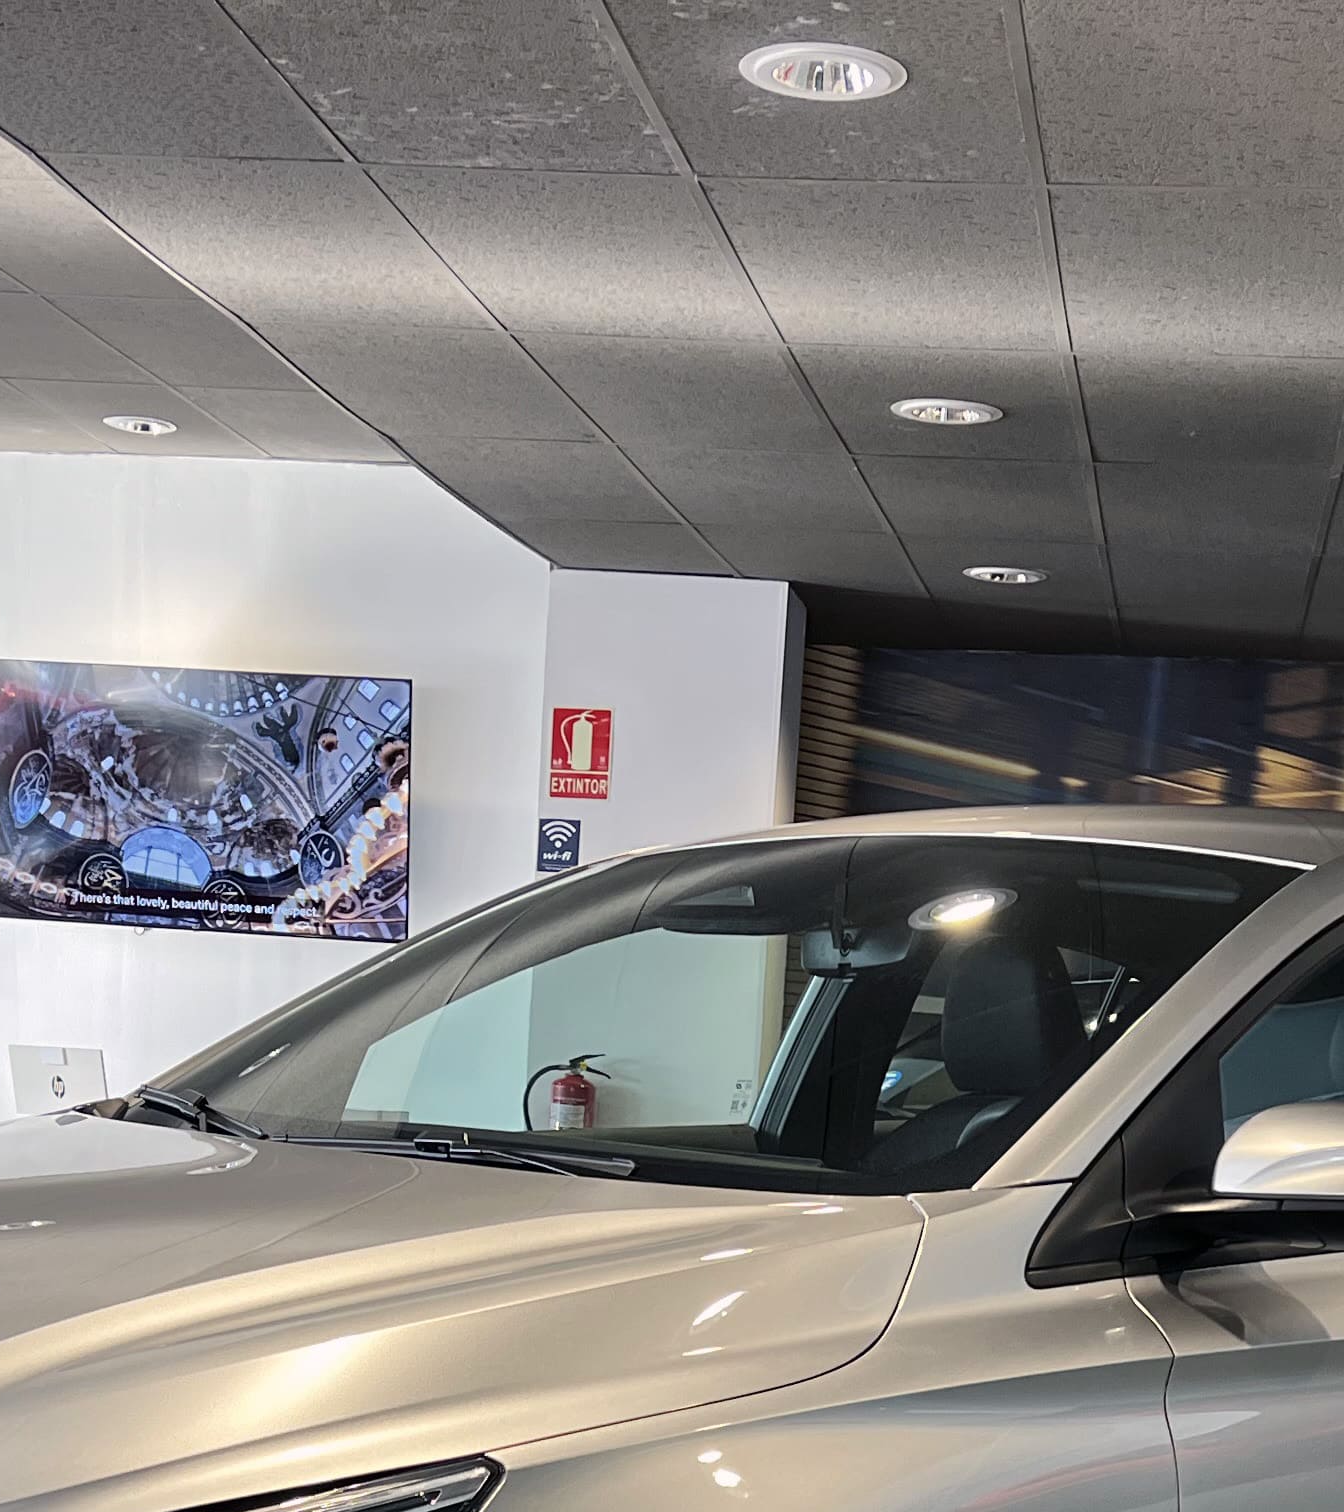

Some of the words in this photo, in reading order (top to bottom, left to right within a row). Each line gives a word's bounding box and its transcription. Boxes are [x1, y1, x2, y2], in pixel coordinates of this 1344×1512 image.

[551, 777, 607, 795] EXTINTOR
[542, 850, 572, 862] wi-fi
[74, 890, 111, 904] There's
[113, 893, 135, 906] that
[136, 895, 170, 910] lovely,
[171, 897, 218, 911] beautiful
[220, 902, 252, 914] peace
[254, 903, 275, 914] and
